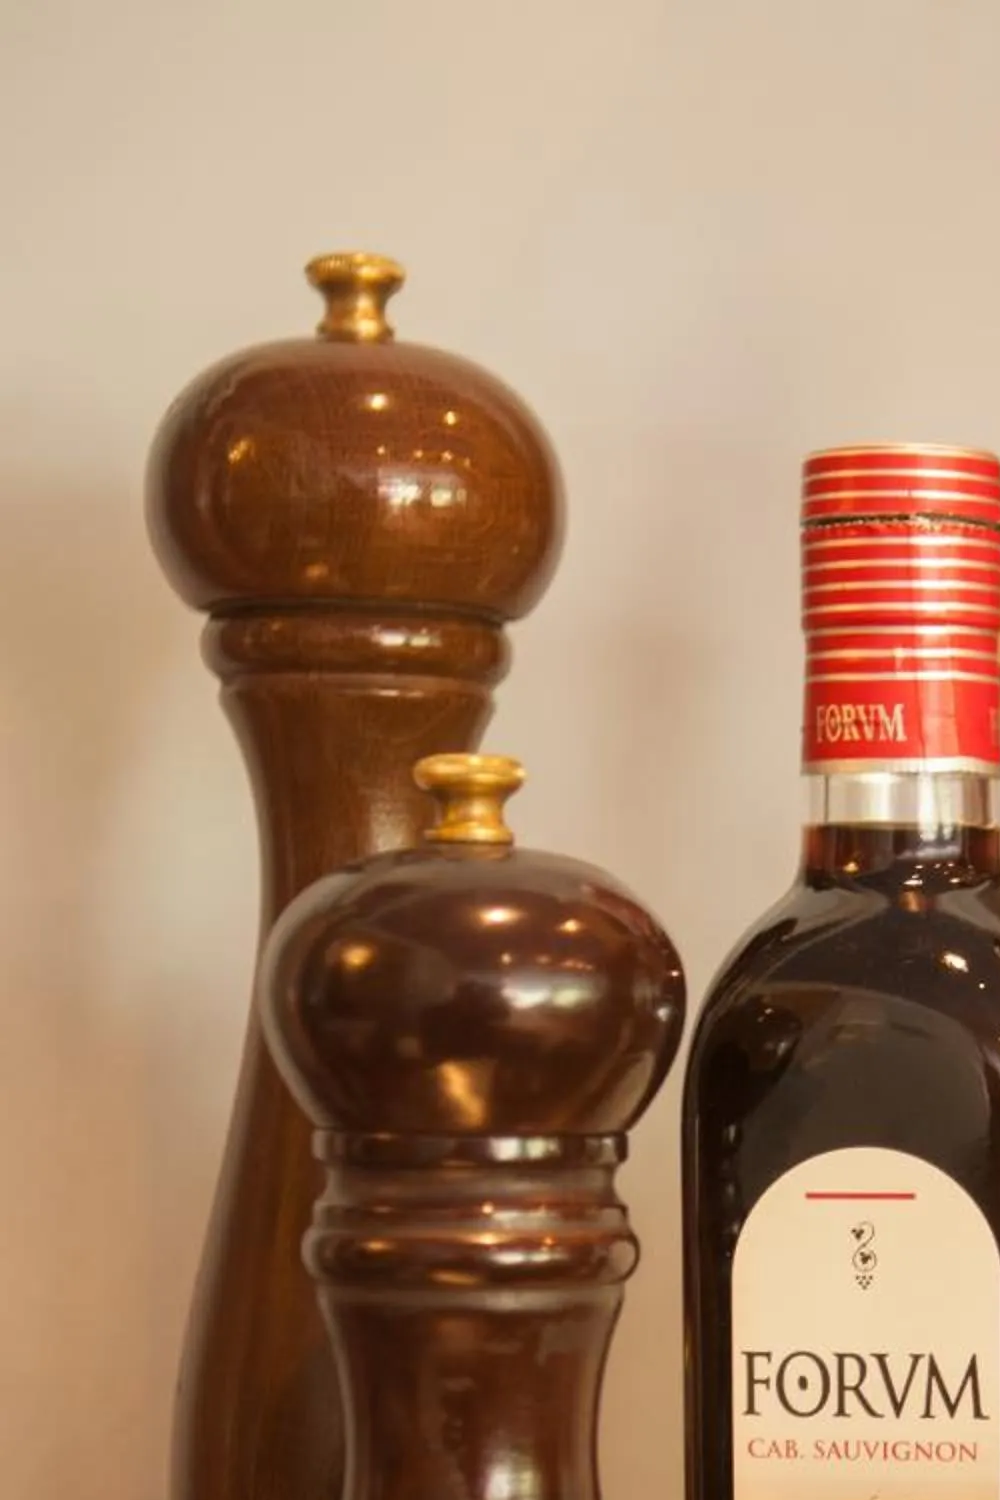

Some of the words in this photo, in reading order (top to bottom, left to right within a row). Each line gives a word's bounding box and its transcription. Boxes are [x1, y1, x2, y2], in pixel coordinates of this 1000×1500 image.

[816, 704, 907, 743] FORVM
[741, 1351, 990, 1420] FORVM
[747, 1438, 804, 1461] CAB.
[813, 1439, 979, 1462] SAUVIGNON
